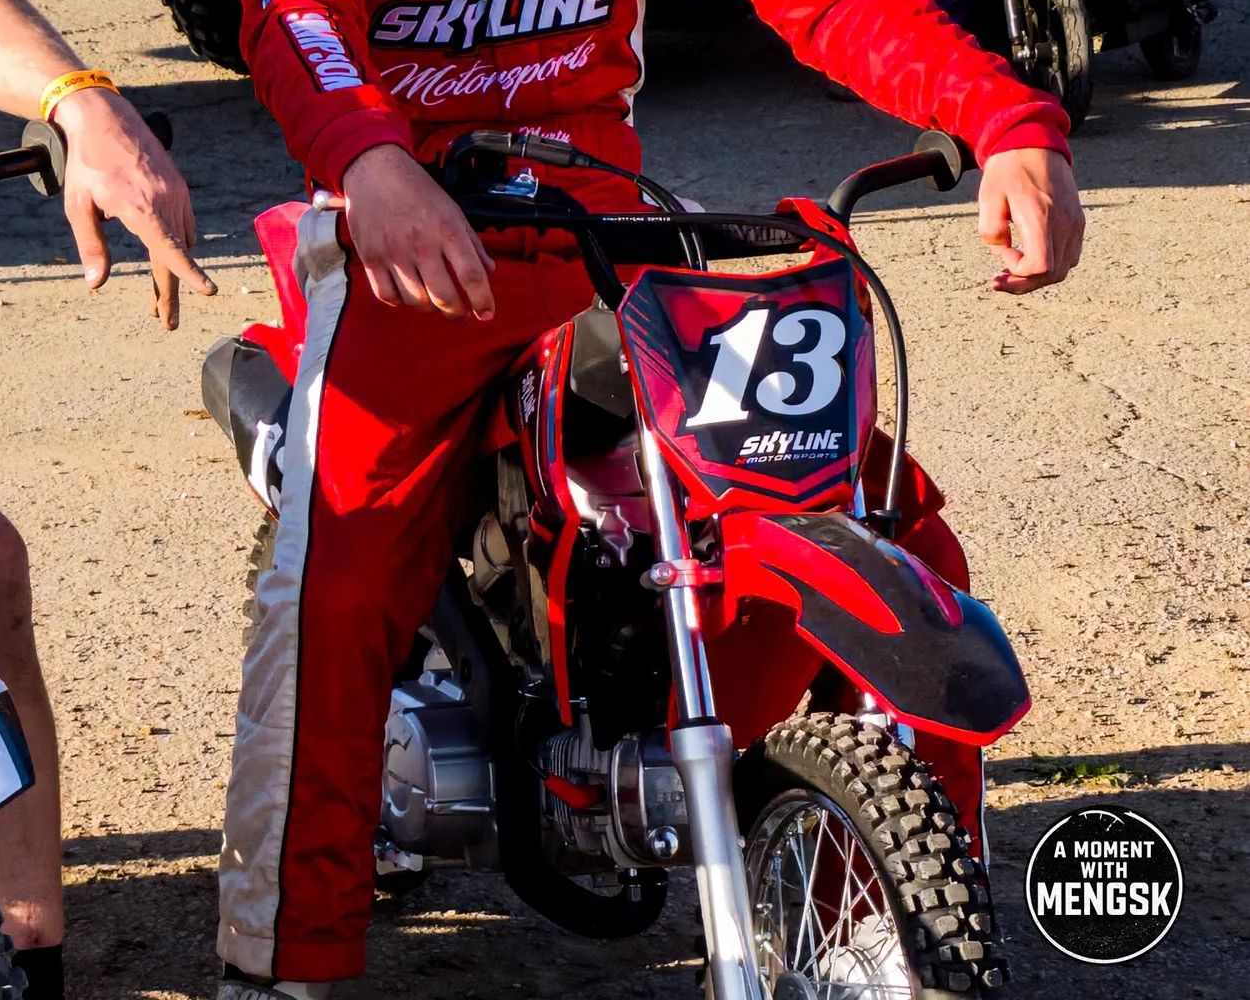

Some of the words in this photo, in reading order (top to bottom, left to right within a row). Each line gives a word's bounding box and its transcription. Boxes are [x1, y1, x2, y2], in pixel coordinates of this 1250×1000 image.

[380, 33, 598, 109] Motorsports
[686, 308, 847, 428] 13
[739, 429, 843, 456] SKYLINE
[746, 453, 839, 464] MOTORSPORTS
